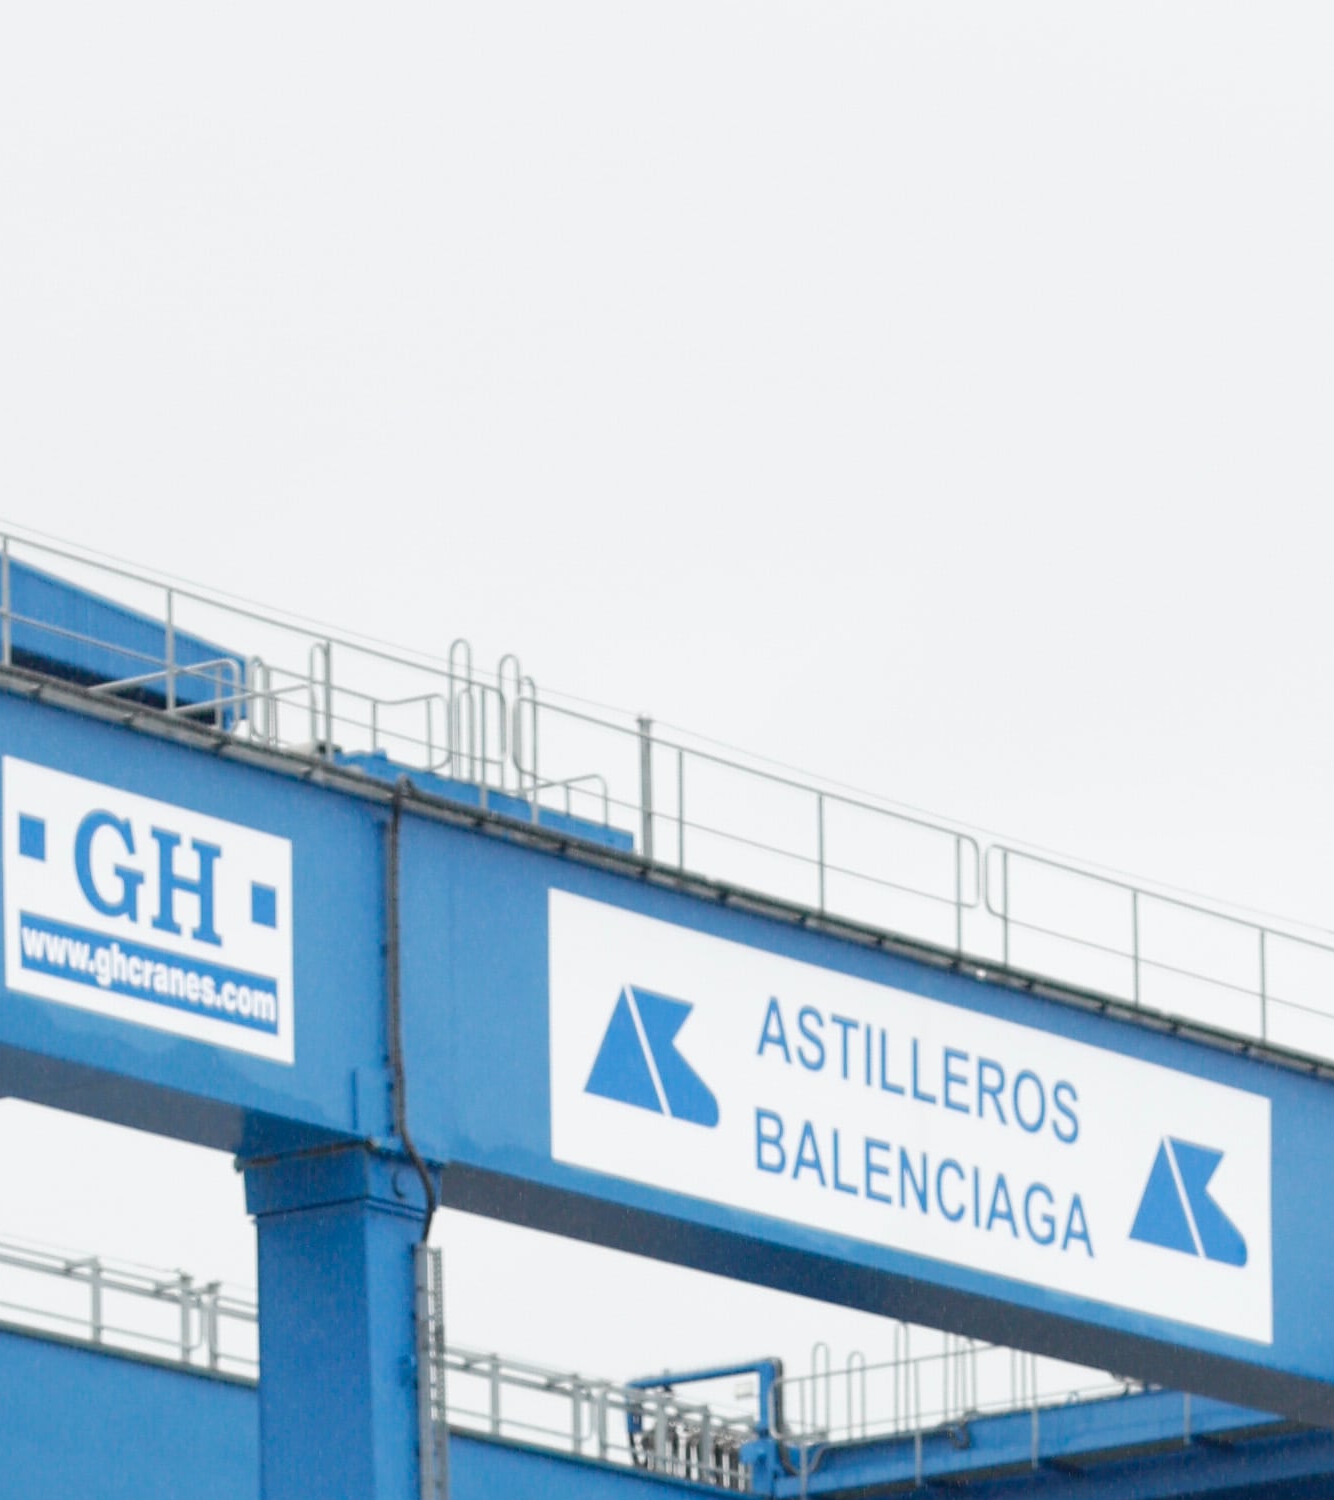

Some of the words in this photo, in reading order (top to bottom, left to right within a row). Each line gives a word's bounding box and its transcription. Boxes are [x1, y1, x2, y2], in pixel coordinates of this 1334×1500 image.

[72, 809, 223, 948] GH
[21, 926, 277, 1023] www.ghcranes.com
[757, 995, 1081, 1145] ASTILLEROS
[754, 1106, 1095, 1259] BALENCIAGA
